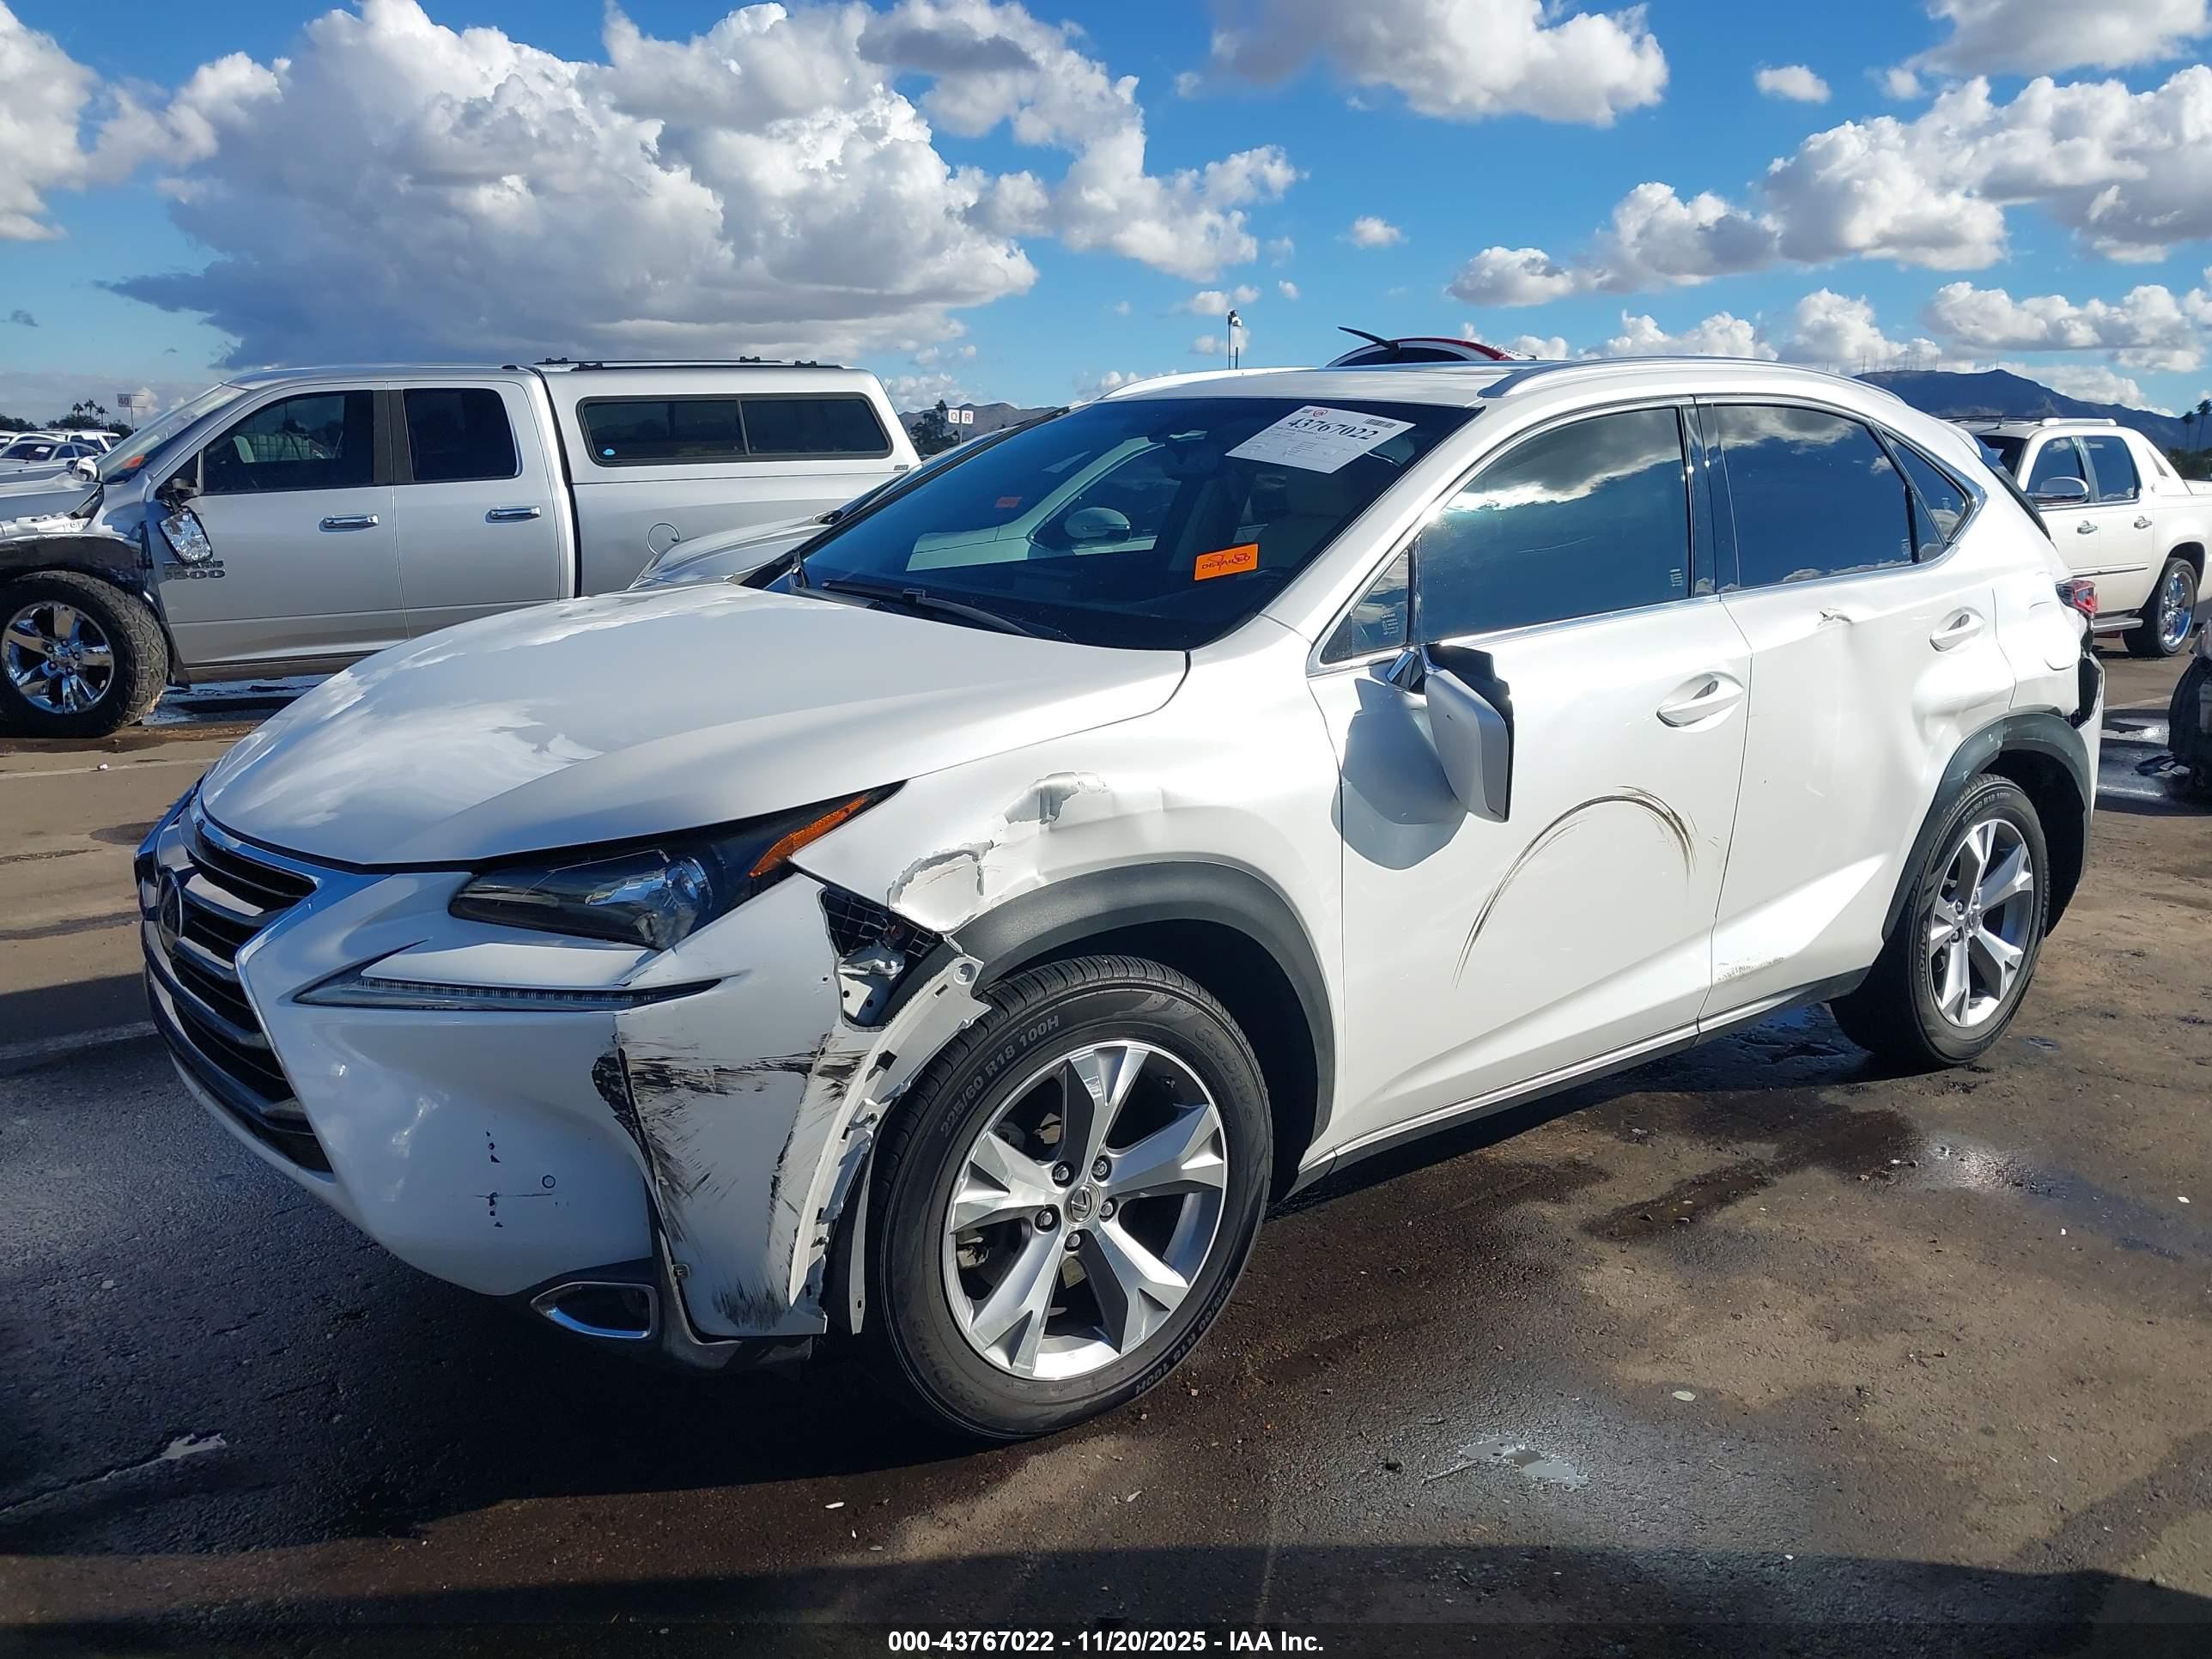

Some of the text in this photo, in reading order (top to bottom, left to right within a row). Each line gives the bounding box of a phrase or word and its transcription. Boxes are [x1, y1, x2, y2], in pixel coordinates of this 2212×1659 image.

[1287, 417, 1379, 441] 43767022
[940, 1015, 1059, 1136] 225/60 R18 100H
